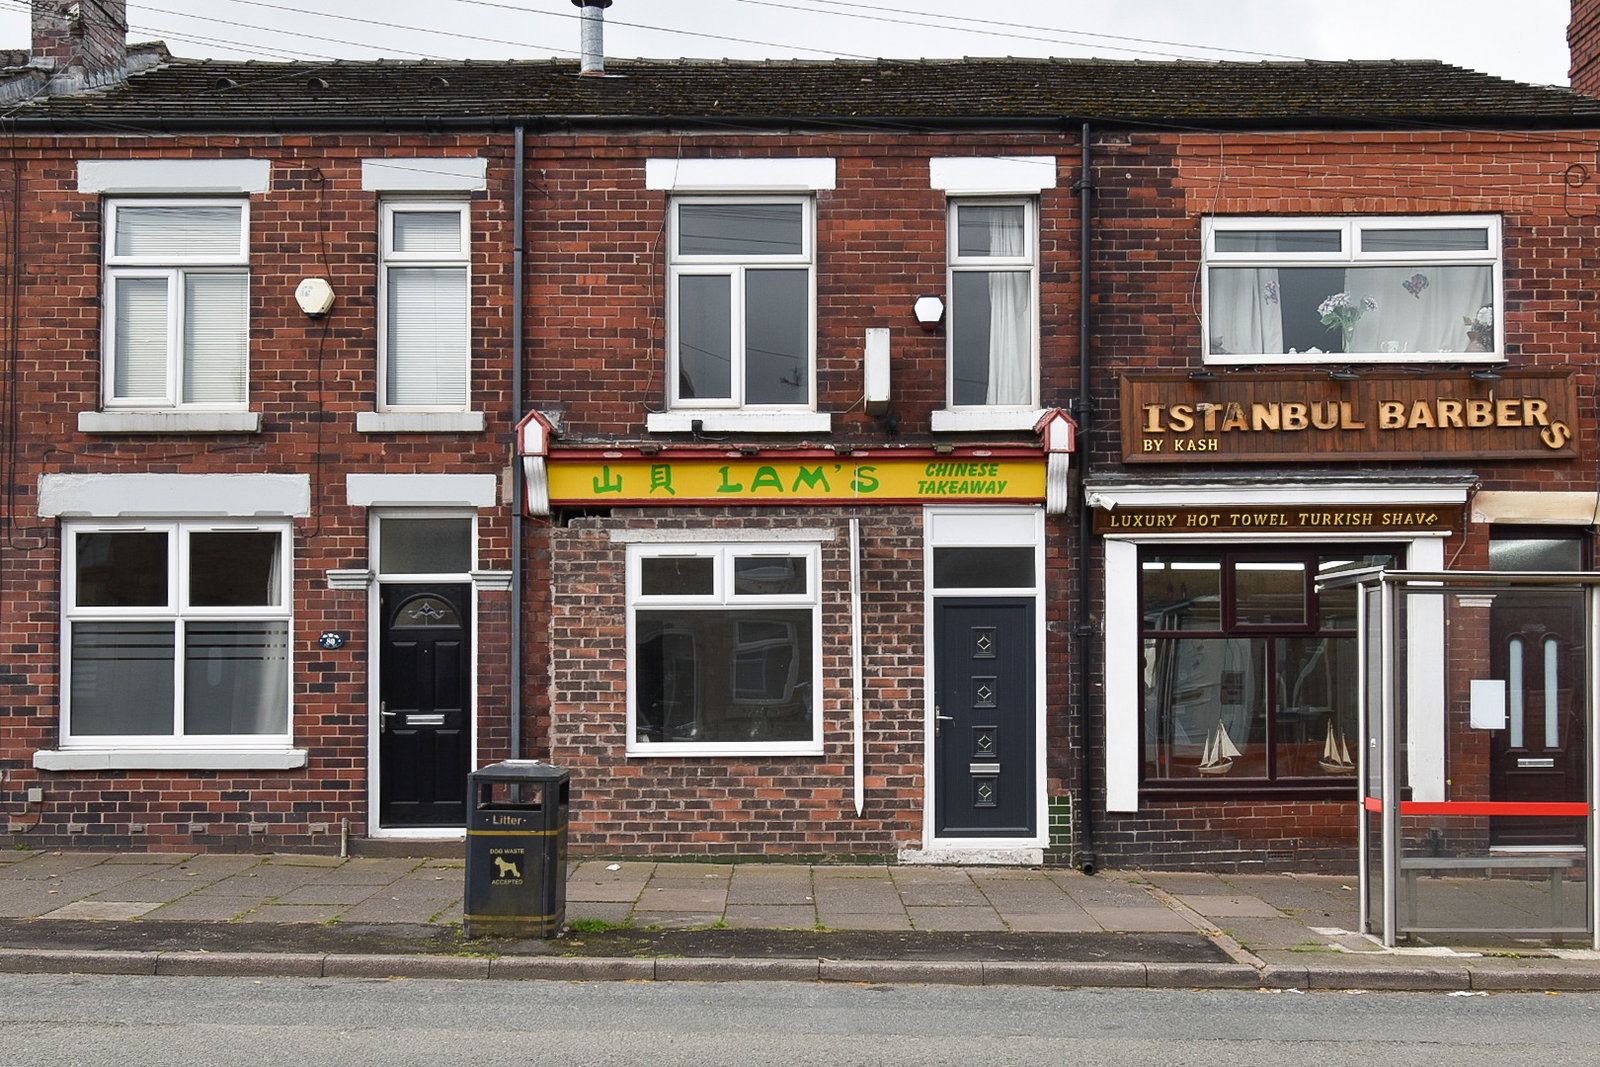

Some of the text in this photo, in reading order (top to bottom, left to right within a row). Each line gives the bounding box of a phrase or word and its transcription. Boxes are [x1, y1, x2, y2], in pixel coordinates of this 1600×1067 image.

[1143, 397, 1572, 449] ISTANBUL BARBERS
[1144, 439, 1218, 451] BY KASH
[925, 463, 999, 477] CHINESE
[716, 464, 879, 493] LAM'S
[917, 480, 1008, 495] TAKEAWAY
[1110, 513, 1438, 527] LUXURY HOT TOWEL TURKISH SHAVE
[492, 815, 522, 825] Litter
